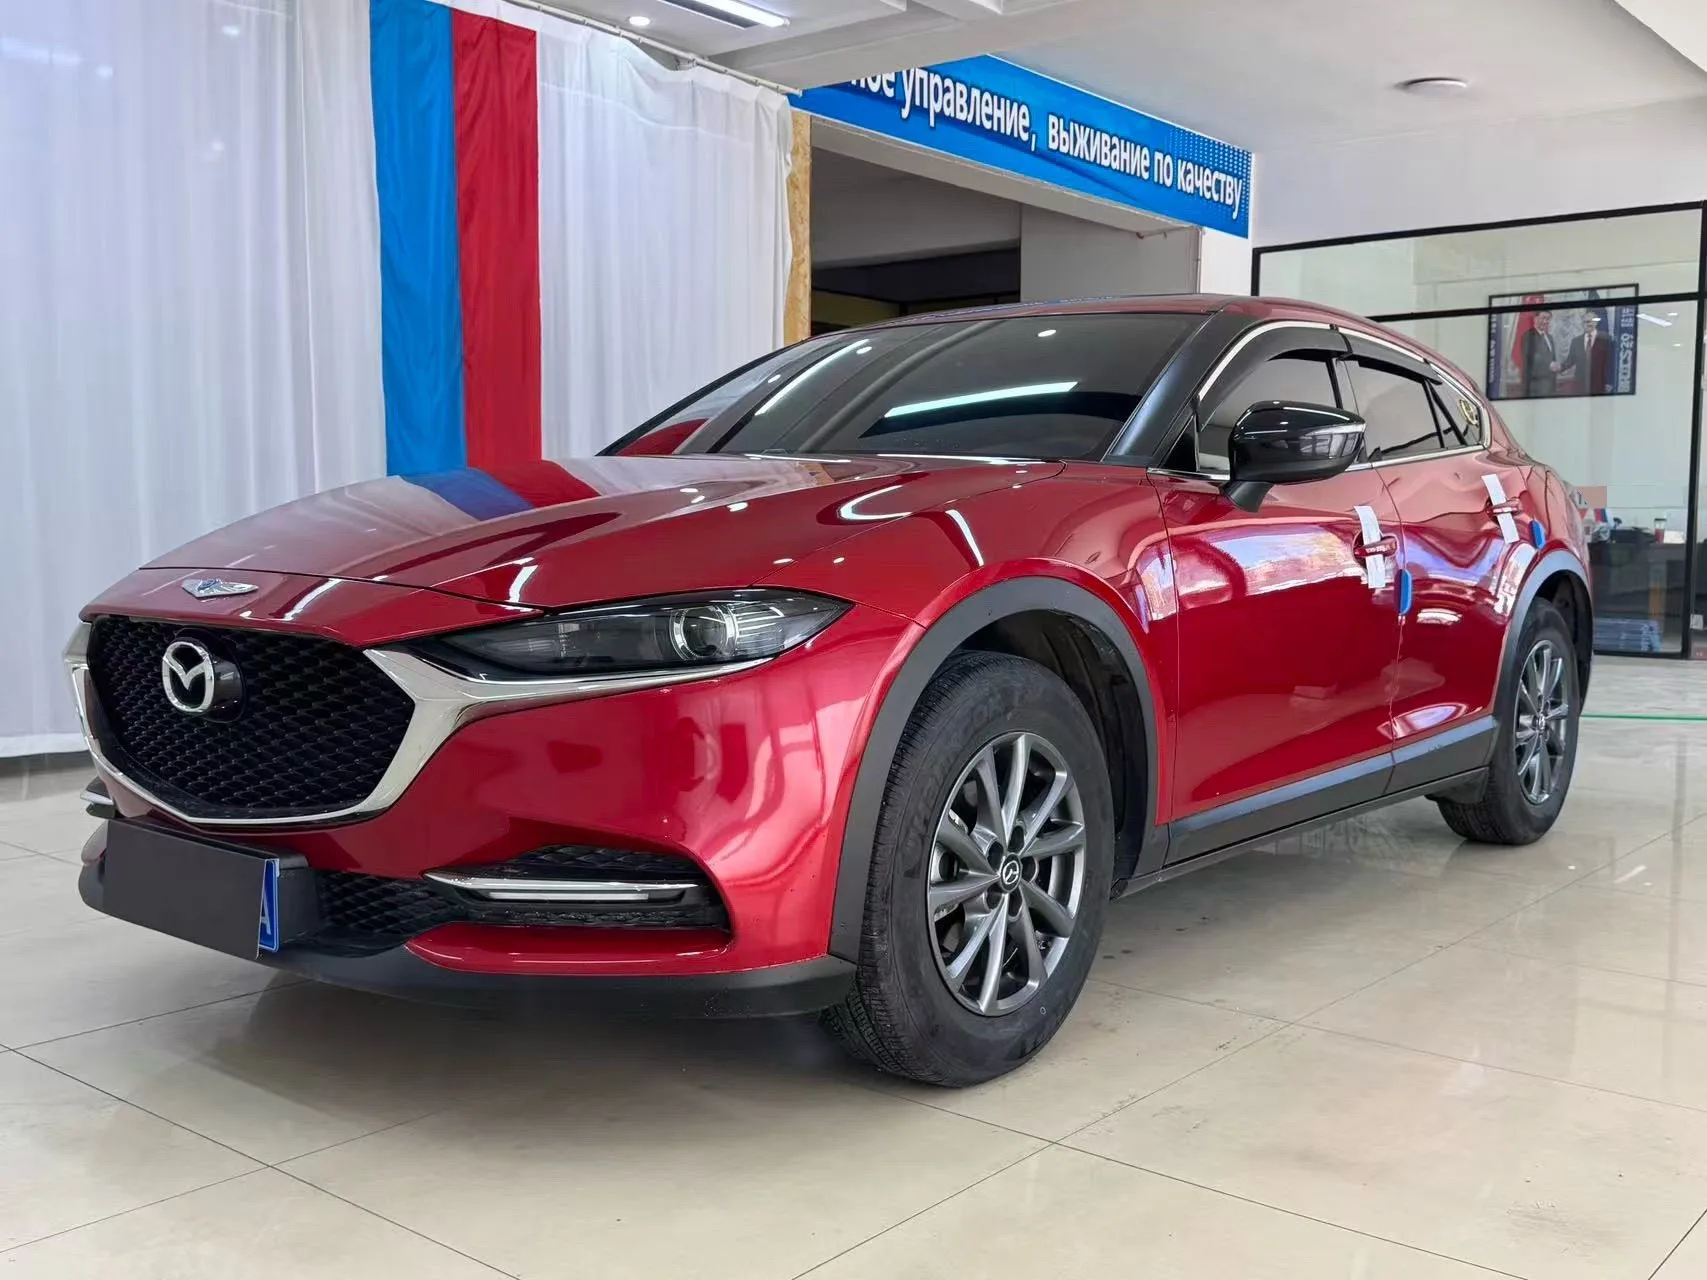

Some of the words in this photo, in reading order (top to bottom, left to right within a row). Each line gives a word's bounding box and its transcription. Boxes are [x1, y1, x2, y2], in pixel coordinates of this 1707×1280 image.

[901, 66, 1036, 151] управление,
[1047, 113, 1150, 181] выживание
[1153, 151, 1174, 189] по
[1177, 160, 1242, 219] качеству
